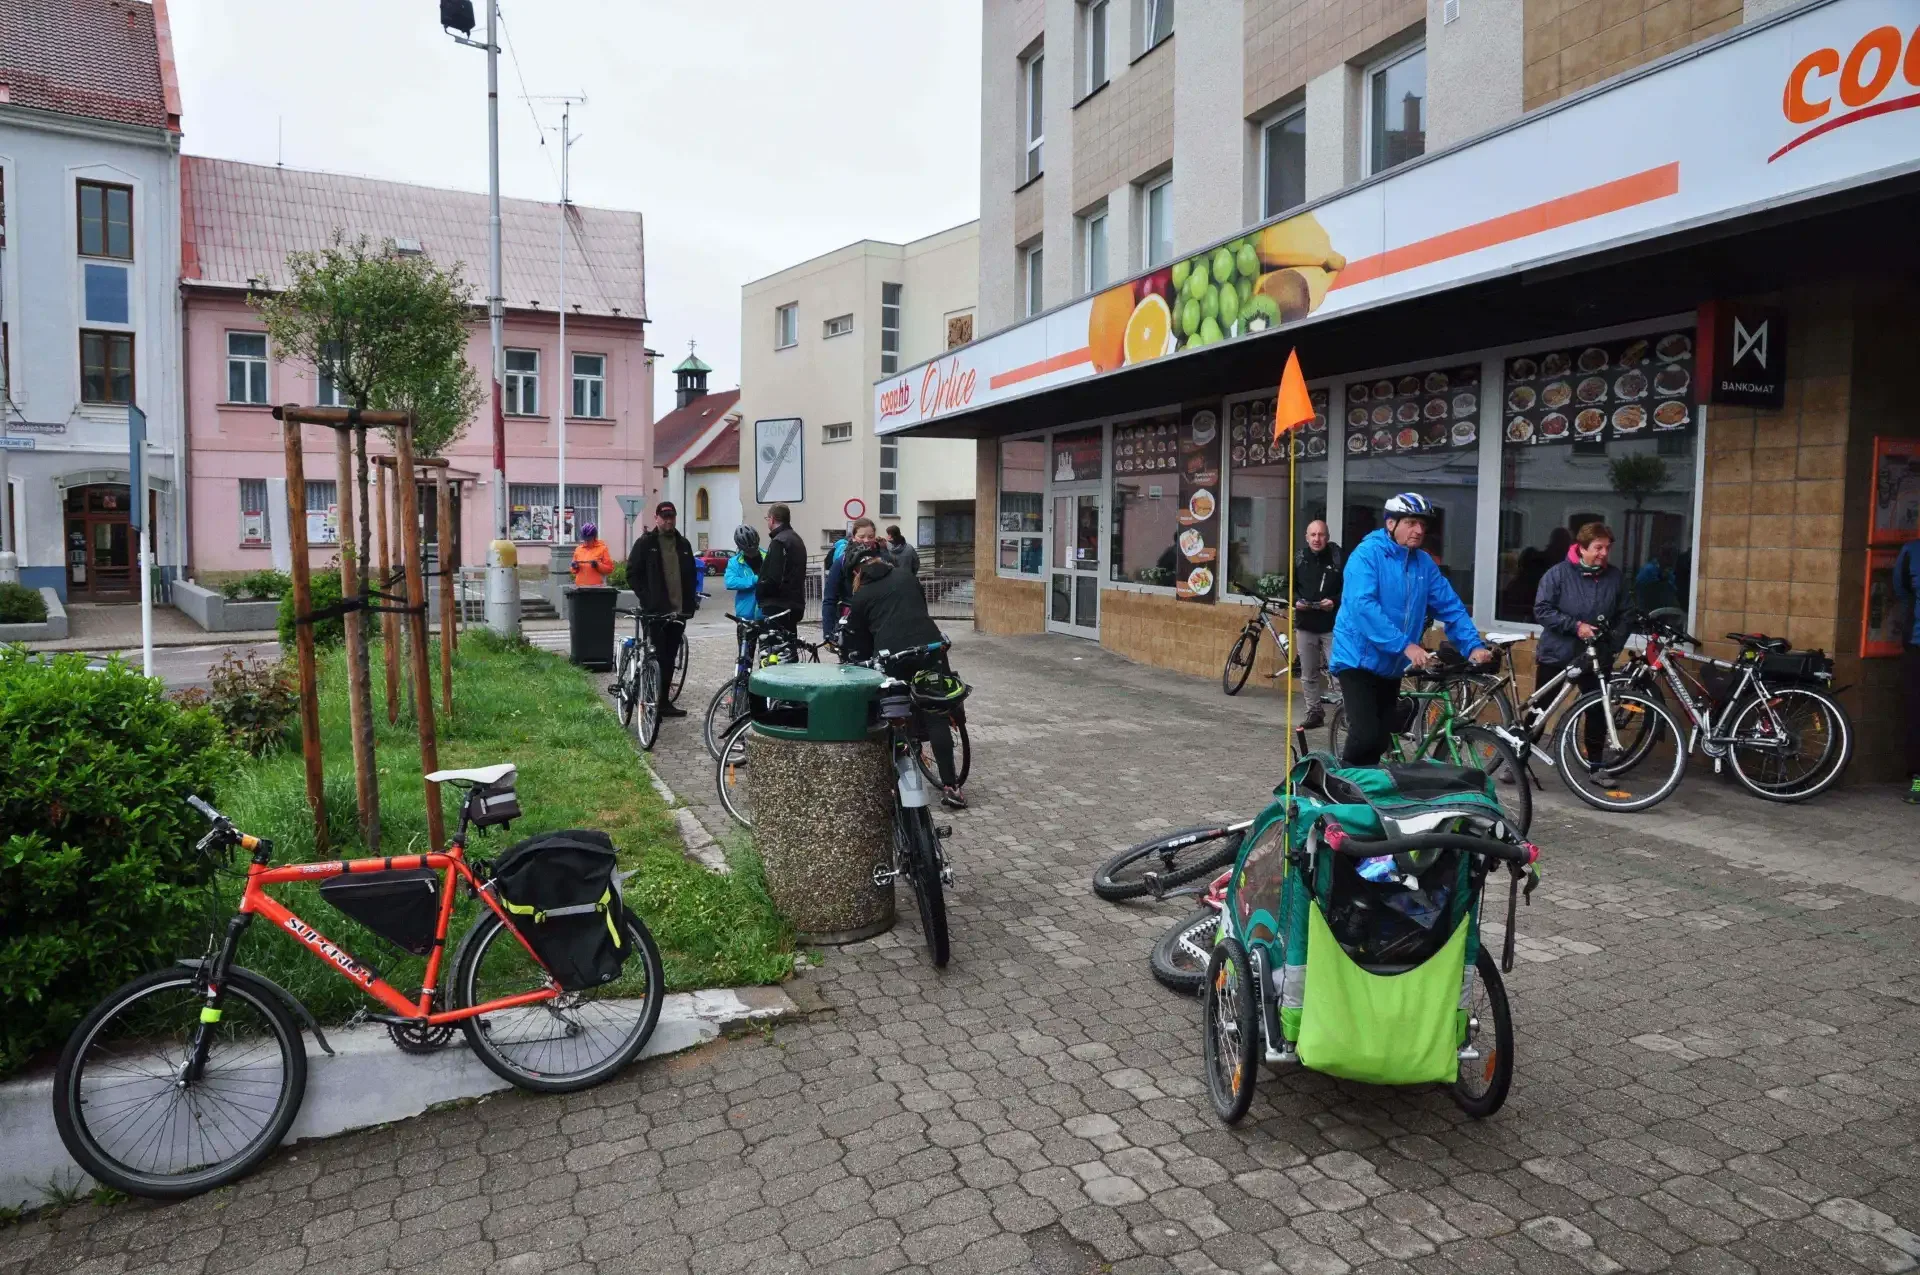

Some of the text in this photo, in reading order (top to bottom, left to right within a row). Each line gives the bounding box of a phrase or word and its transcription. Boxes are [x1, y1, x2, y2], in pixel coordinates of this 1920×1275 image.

[920, 356, 977, 420] Orlice
[1721, 381, 1775, 394] BANKOMAT
[284, 916, 376, 988] SUPERIOR
